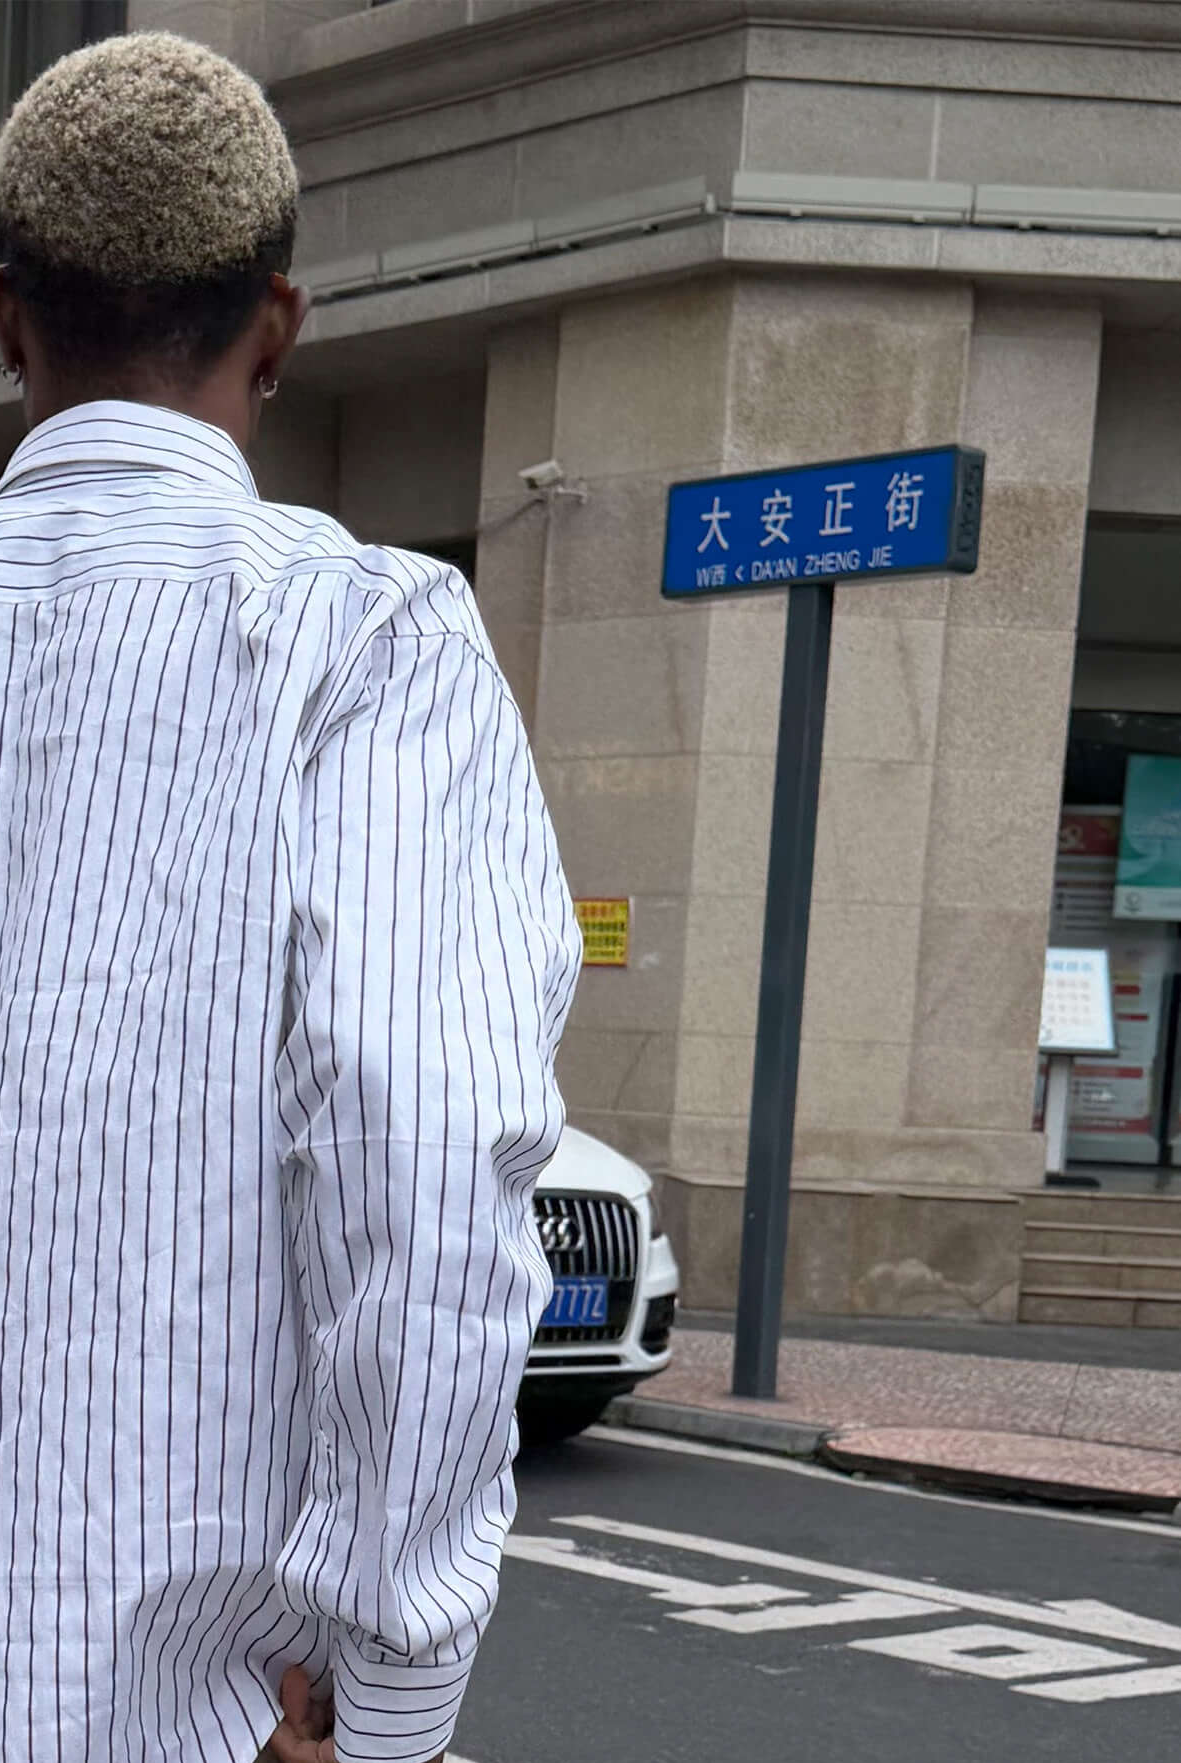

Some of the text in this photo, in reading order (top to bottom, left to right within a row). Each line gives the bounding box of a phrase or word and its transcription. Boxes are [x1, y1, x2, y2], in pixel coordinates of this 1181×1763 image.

[697, 472, 924, 553] 大安正街
[804, 549, 860, 575] ZHENG
[868, 546, 893, 568] JIE
